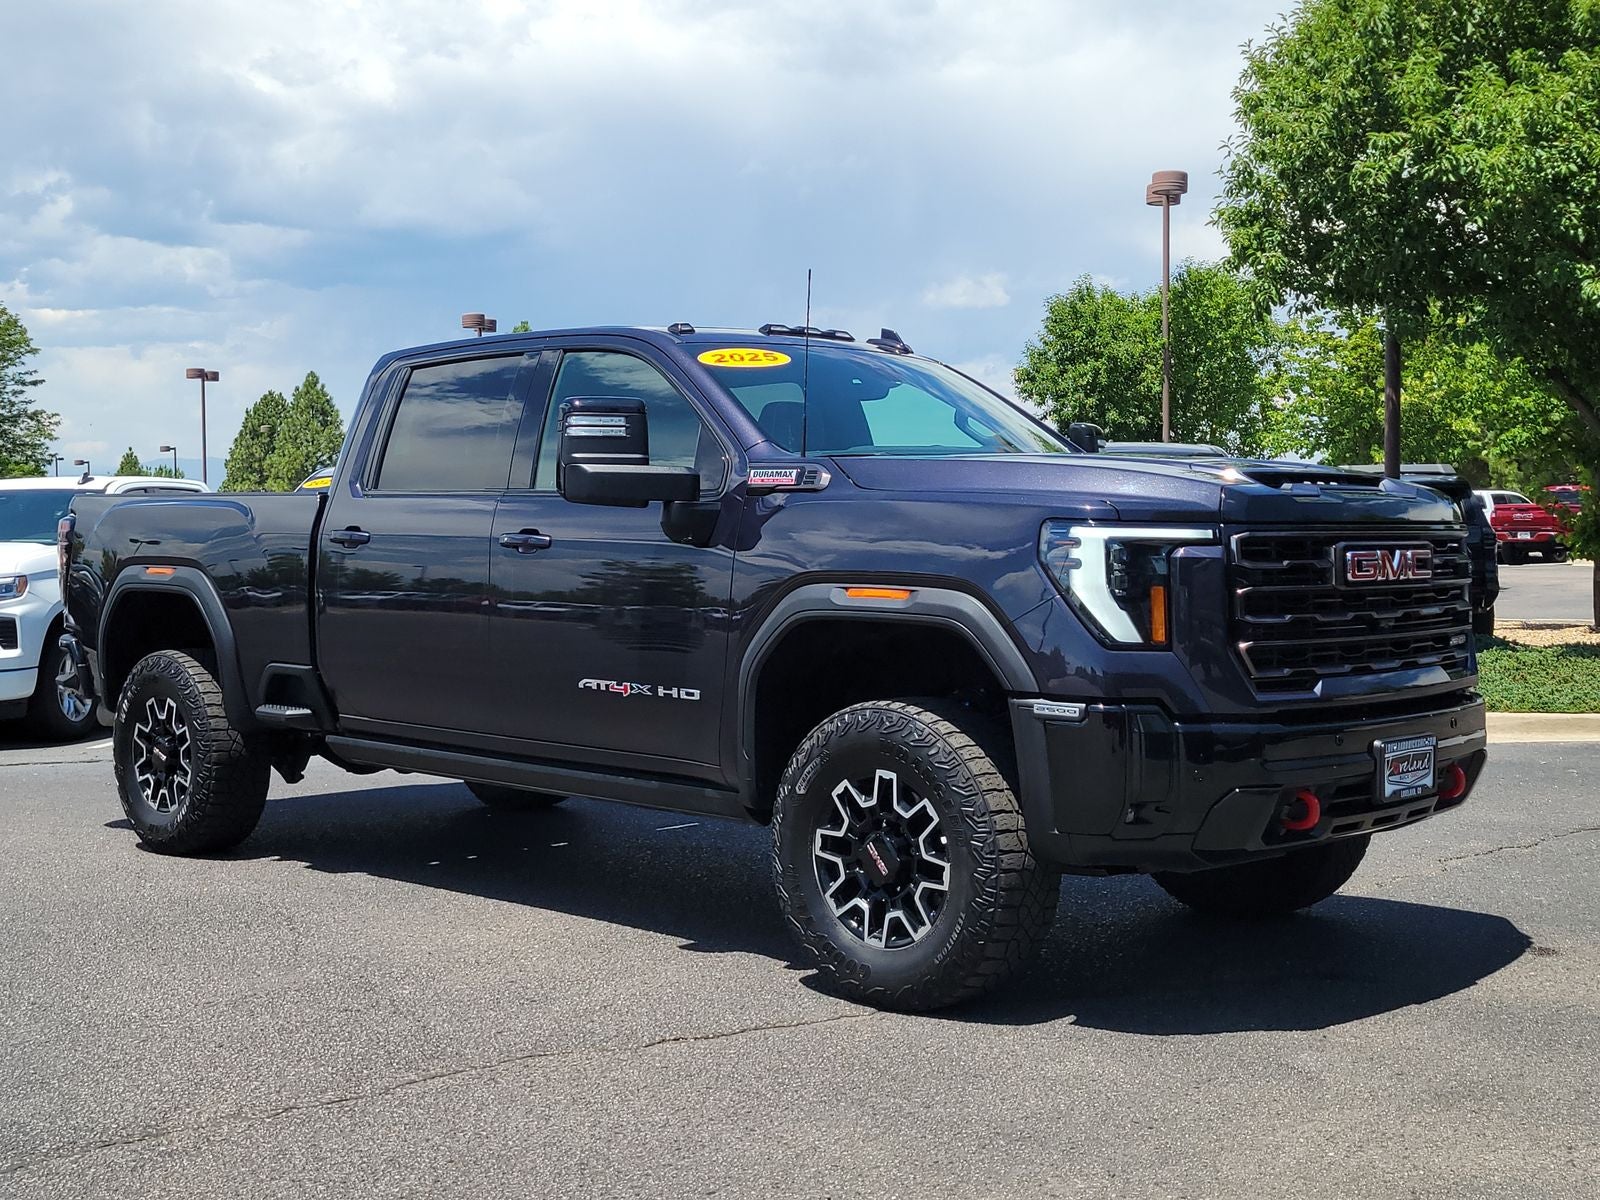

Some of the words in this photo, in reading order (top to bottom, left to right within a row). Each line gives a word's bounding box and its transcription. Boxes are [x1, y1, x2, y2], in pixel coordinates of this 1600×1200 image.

[711, 352, 779, 364] 2025
[752, 470, 794, 478] DURAMAX
[1346, 549, 1432, 580] GMC
[578, 678, 653, 697] AT4X
[657, 685, 701, 701] HD
[1035, 705, 1077, 715] 2500
